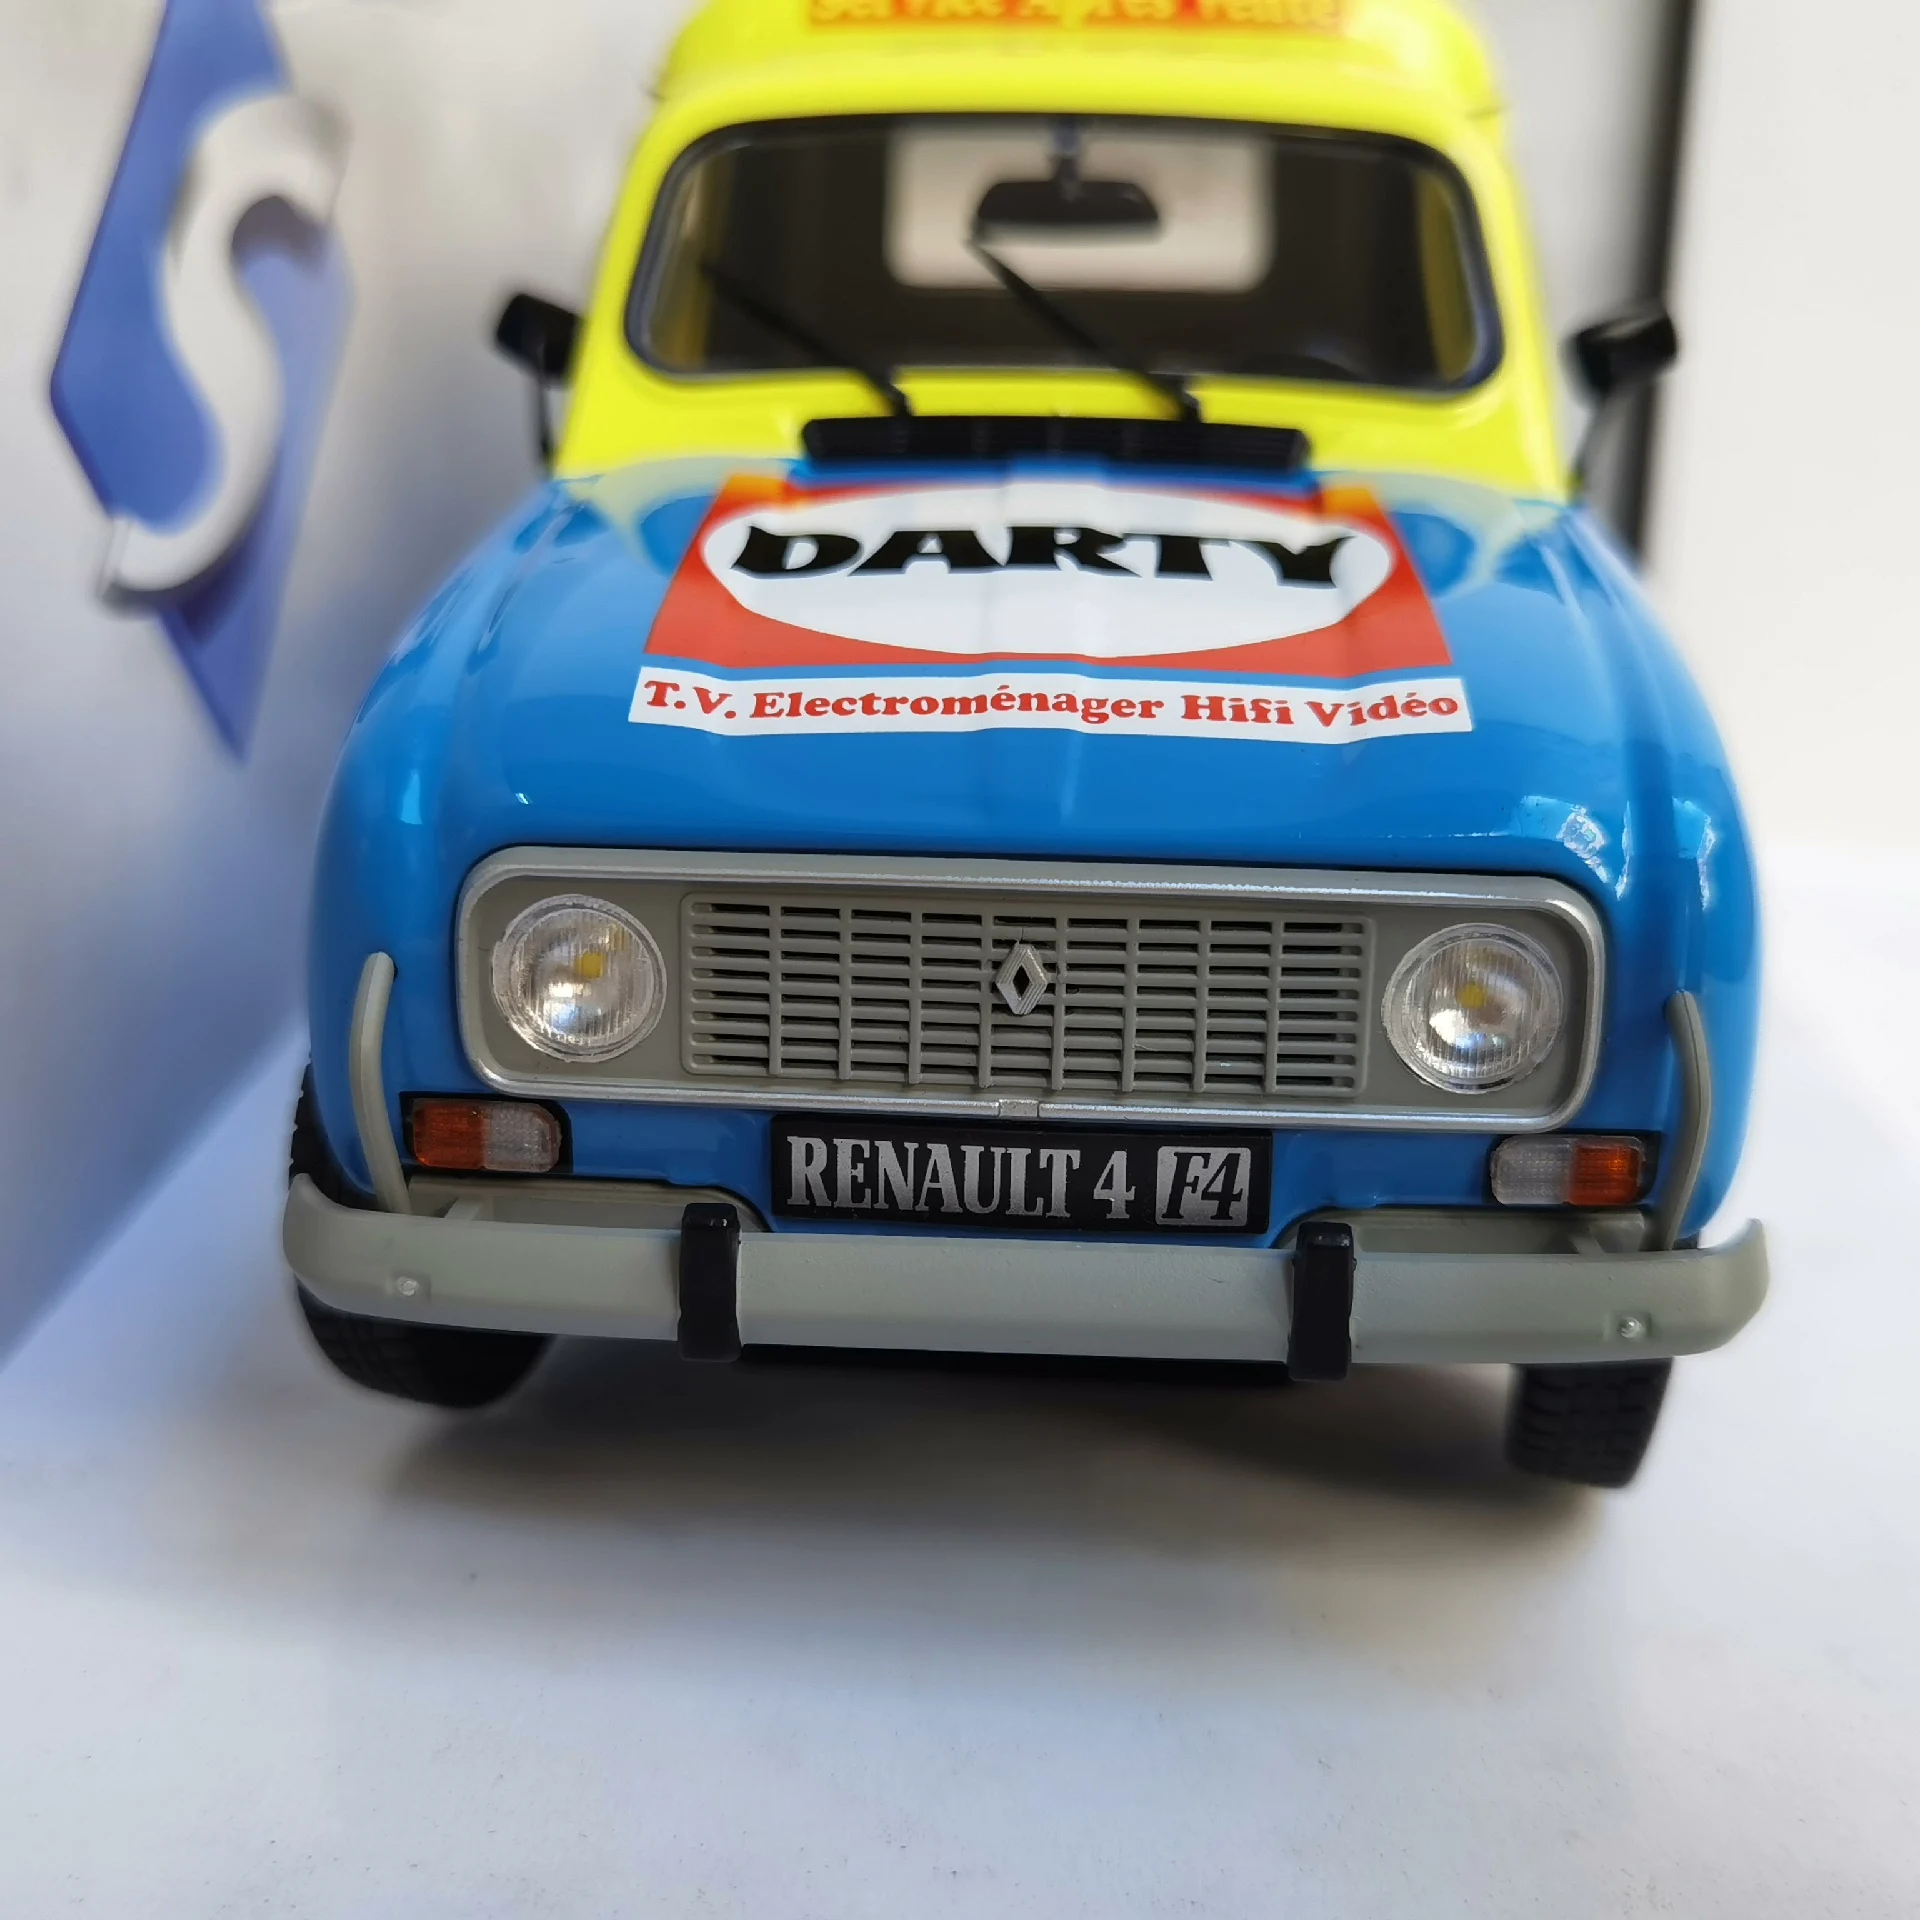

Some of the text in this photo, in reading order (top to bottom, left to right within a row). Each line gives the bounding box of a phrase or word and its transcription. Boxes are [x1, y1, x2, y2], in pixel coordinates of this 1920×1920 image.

[730, 524, 1354, 590] DARTY
[643, 680, 1459, 728] T.V. Electroménager Hifi Vidéo
[786, 1135, 1243, 1220] RENAULT 4 F4
